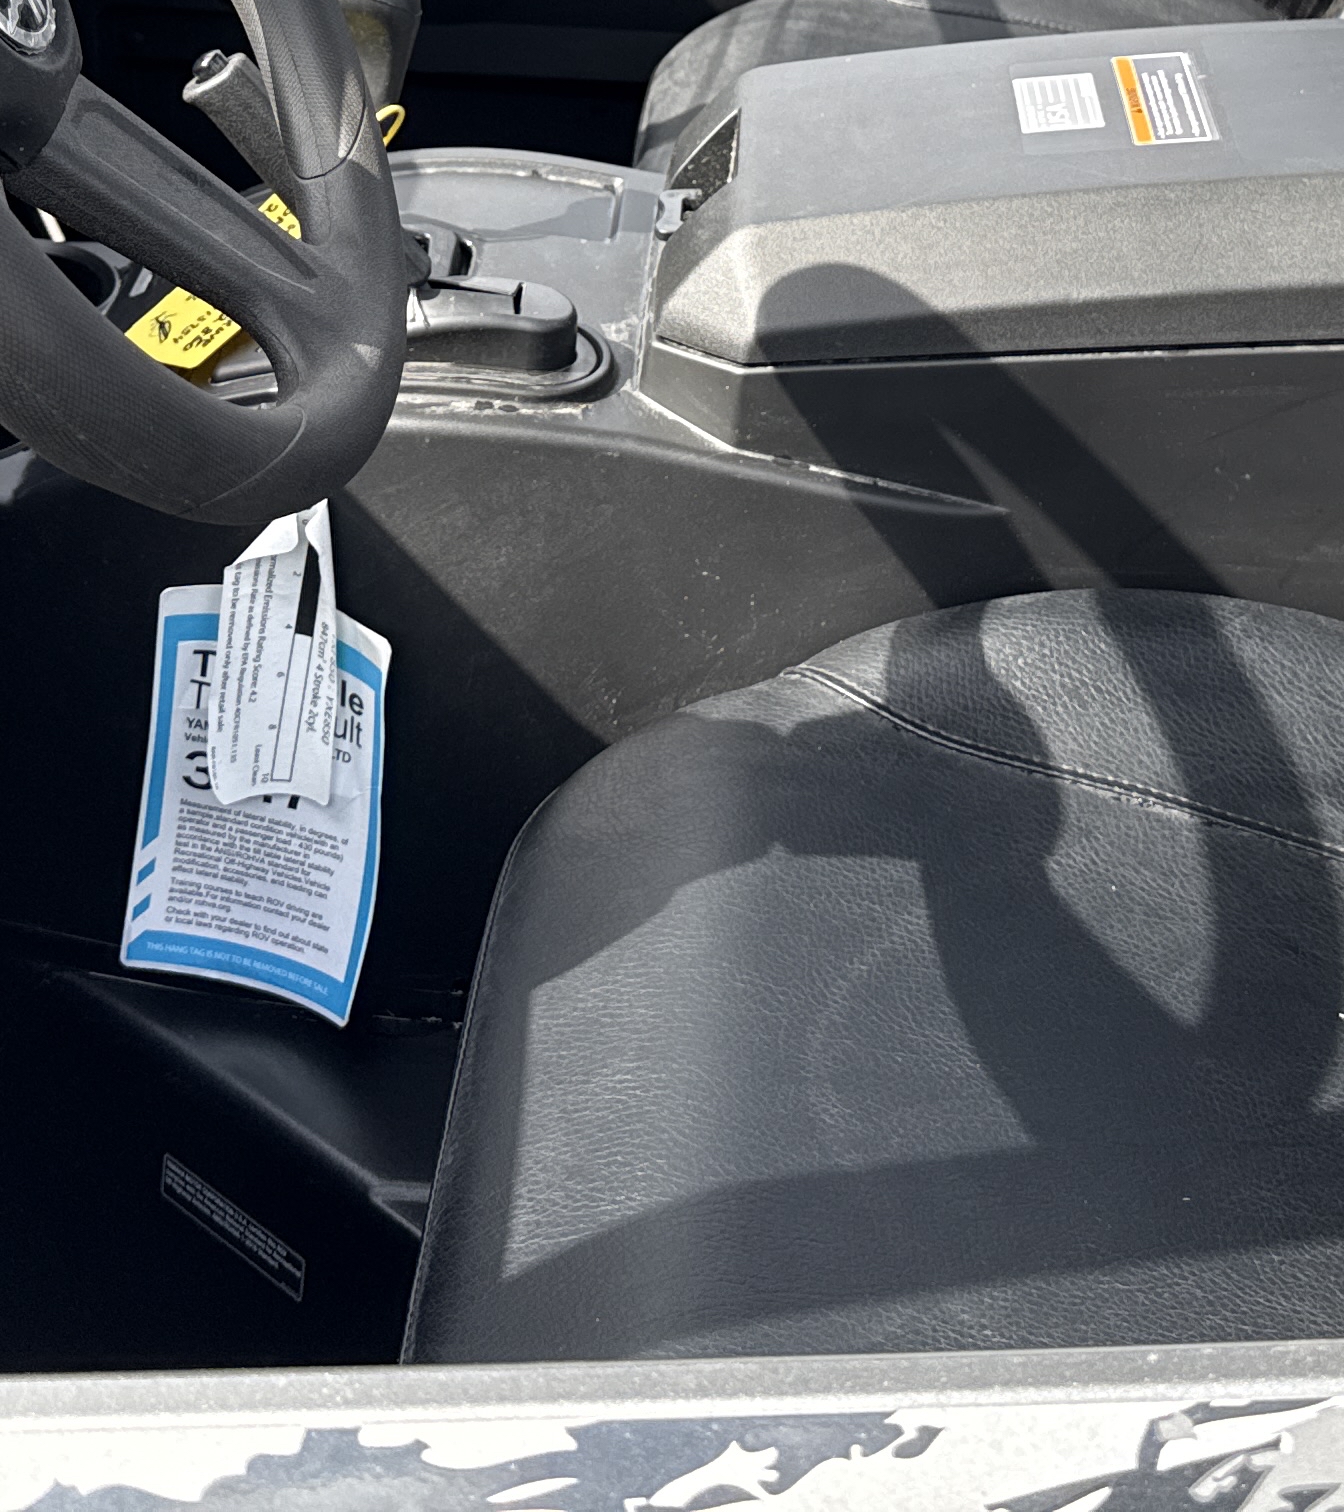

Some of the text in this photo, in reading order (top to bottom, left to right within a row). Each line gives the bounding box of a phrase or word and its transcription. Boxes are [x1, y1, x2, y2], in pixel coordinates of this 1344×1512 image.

[231, 586, 240, 597] to
[229, 597, 240, 609] be
[258, 593, 272, 635] Emissions
[252, 635, 266, 663] Rating
[314, 663, 325, 672] 4
[247, 689, 258, 704] 4.2
[309, 671, 324, 708] Stroke
